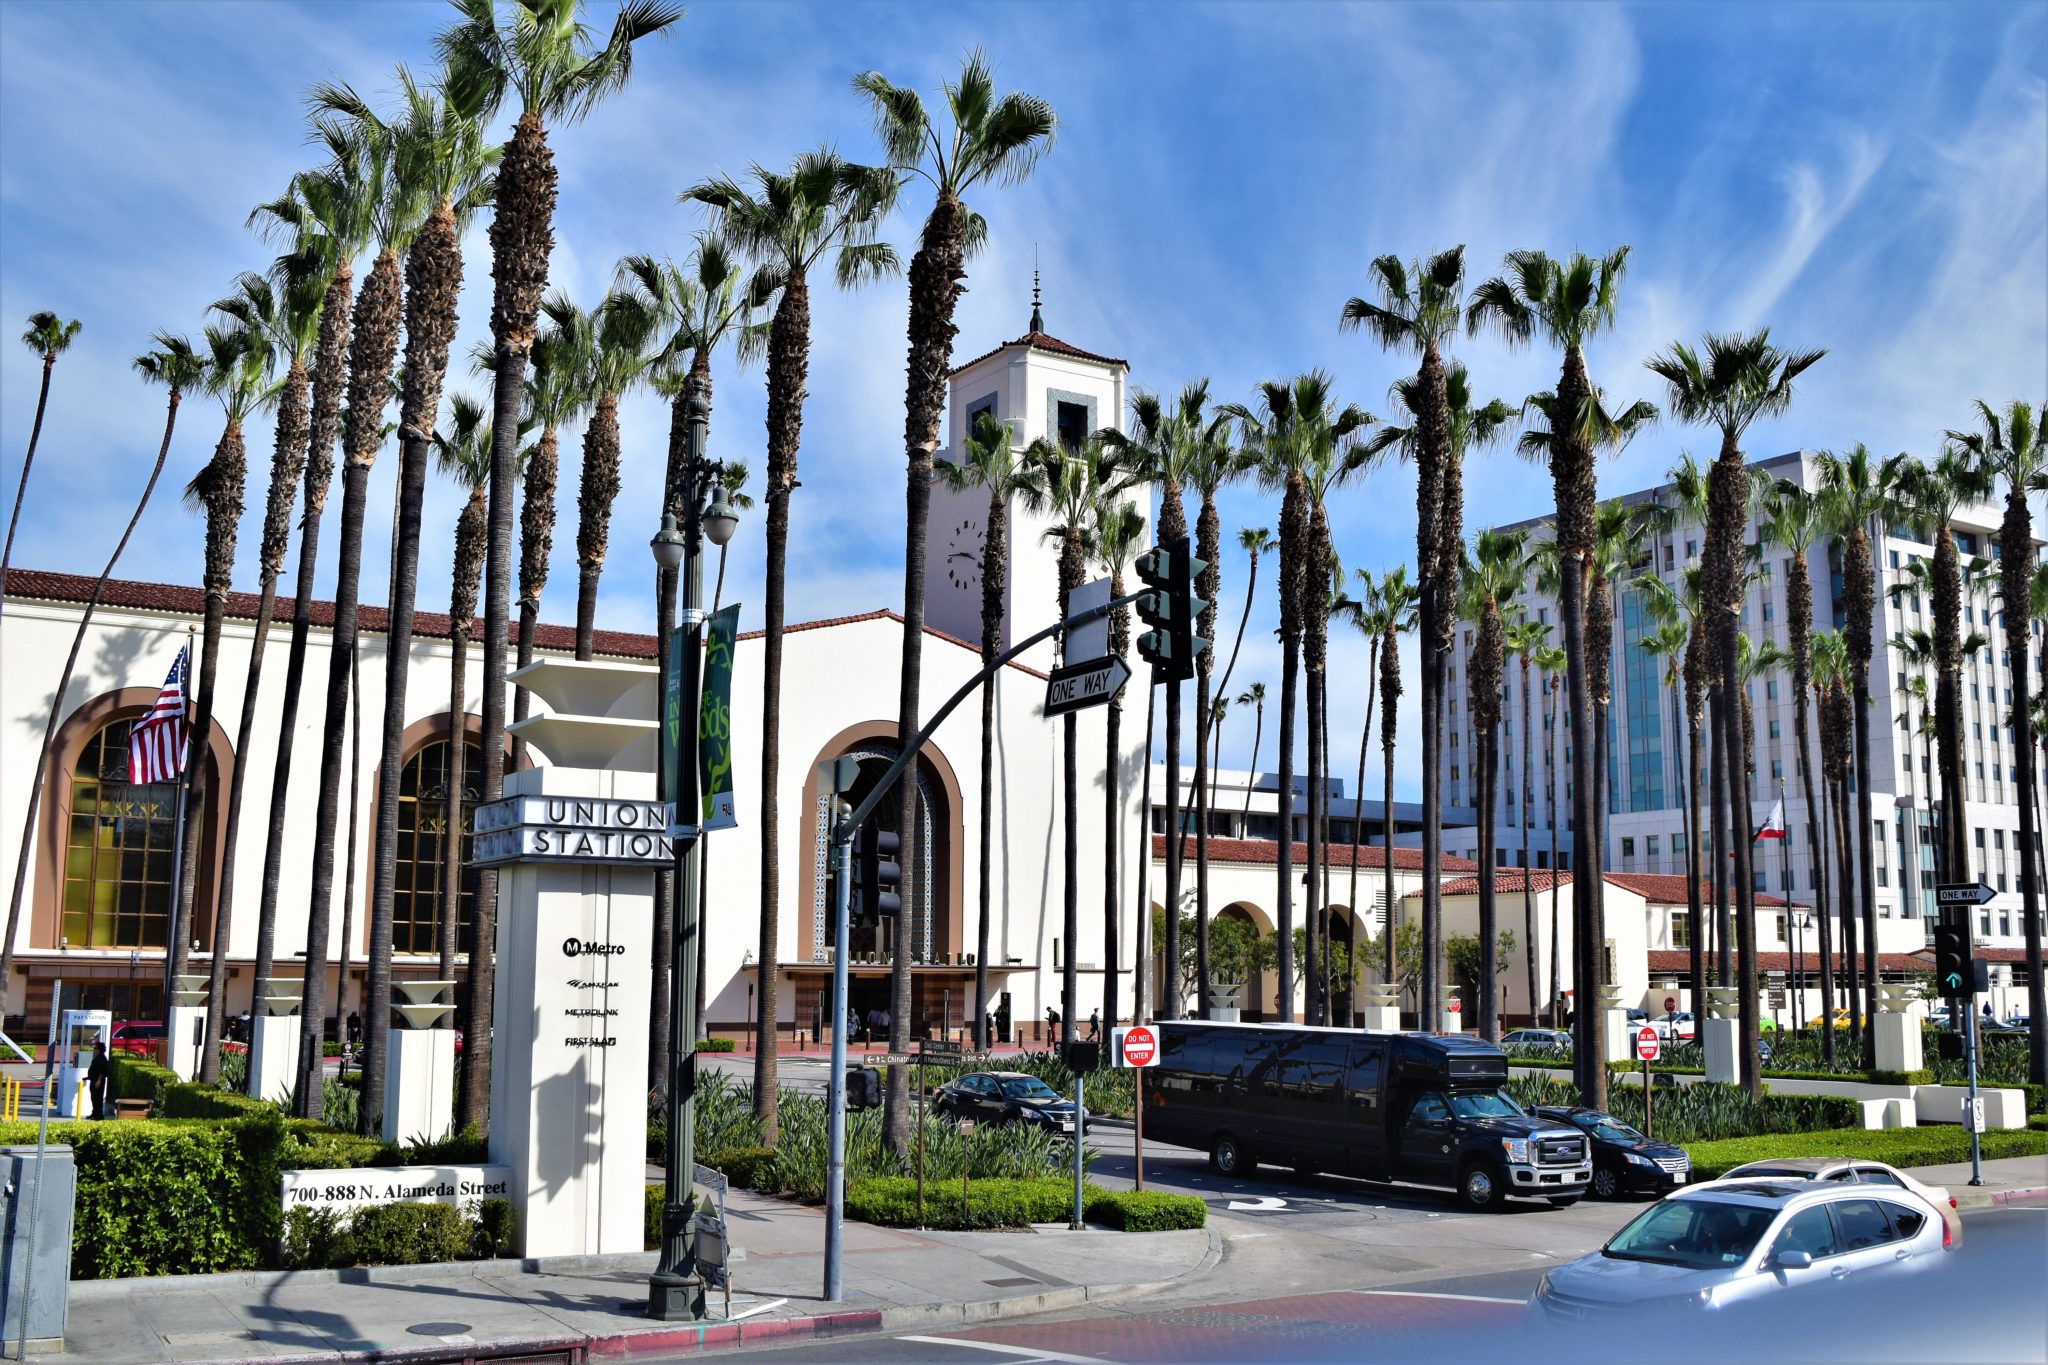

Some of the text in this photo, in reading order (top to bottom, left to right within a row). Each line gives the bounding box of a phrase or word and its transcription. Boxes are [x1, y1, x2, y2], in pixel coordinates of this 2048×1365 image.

[1052, 671, 1111, 702] ONE WAY
[699, 696, 729, 740] ods
[549, 800, 664, 827] UNION
[535, 829, 675, 858] STATION
[1942, 889, 1979, 900] ONE WAY
[585, 941, 625, 955] Metro
[565, 1009, 619, 1017] METROLINK
[1129, 1034, 1150, 1043] DO NOT
[887, 1055, 918, 1063] Chinatown
[1130, 1052, 1149, 1060] ENTER
[289, 1180, 507, 1202] 700-888 N. Alameda Street
